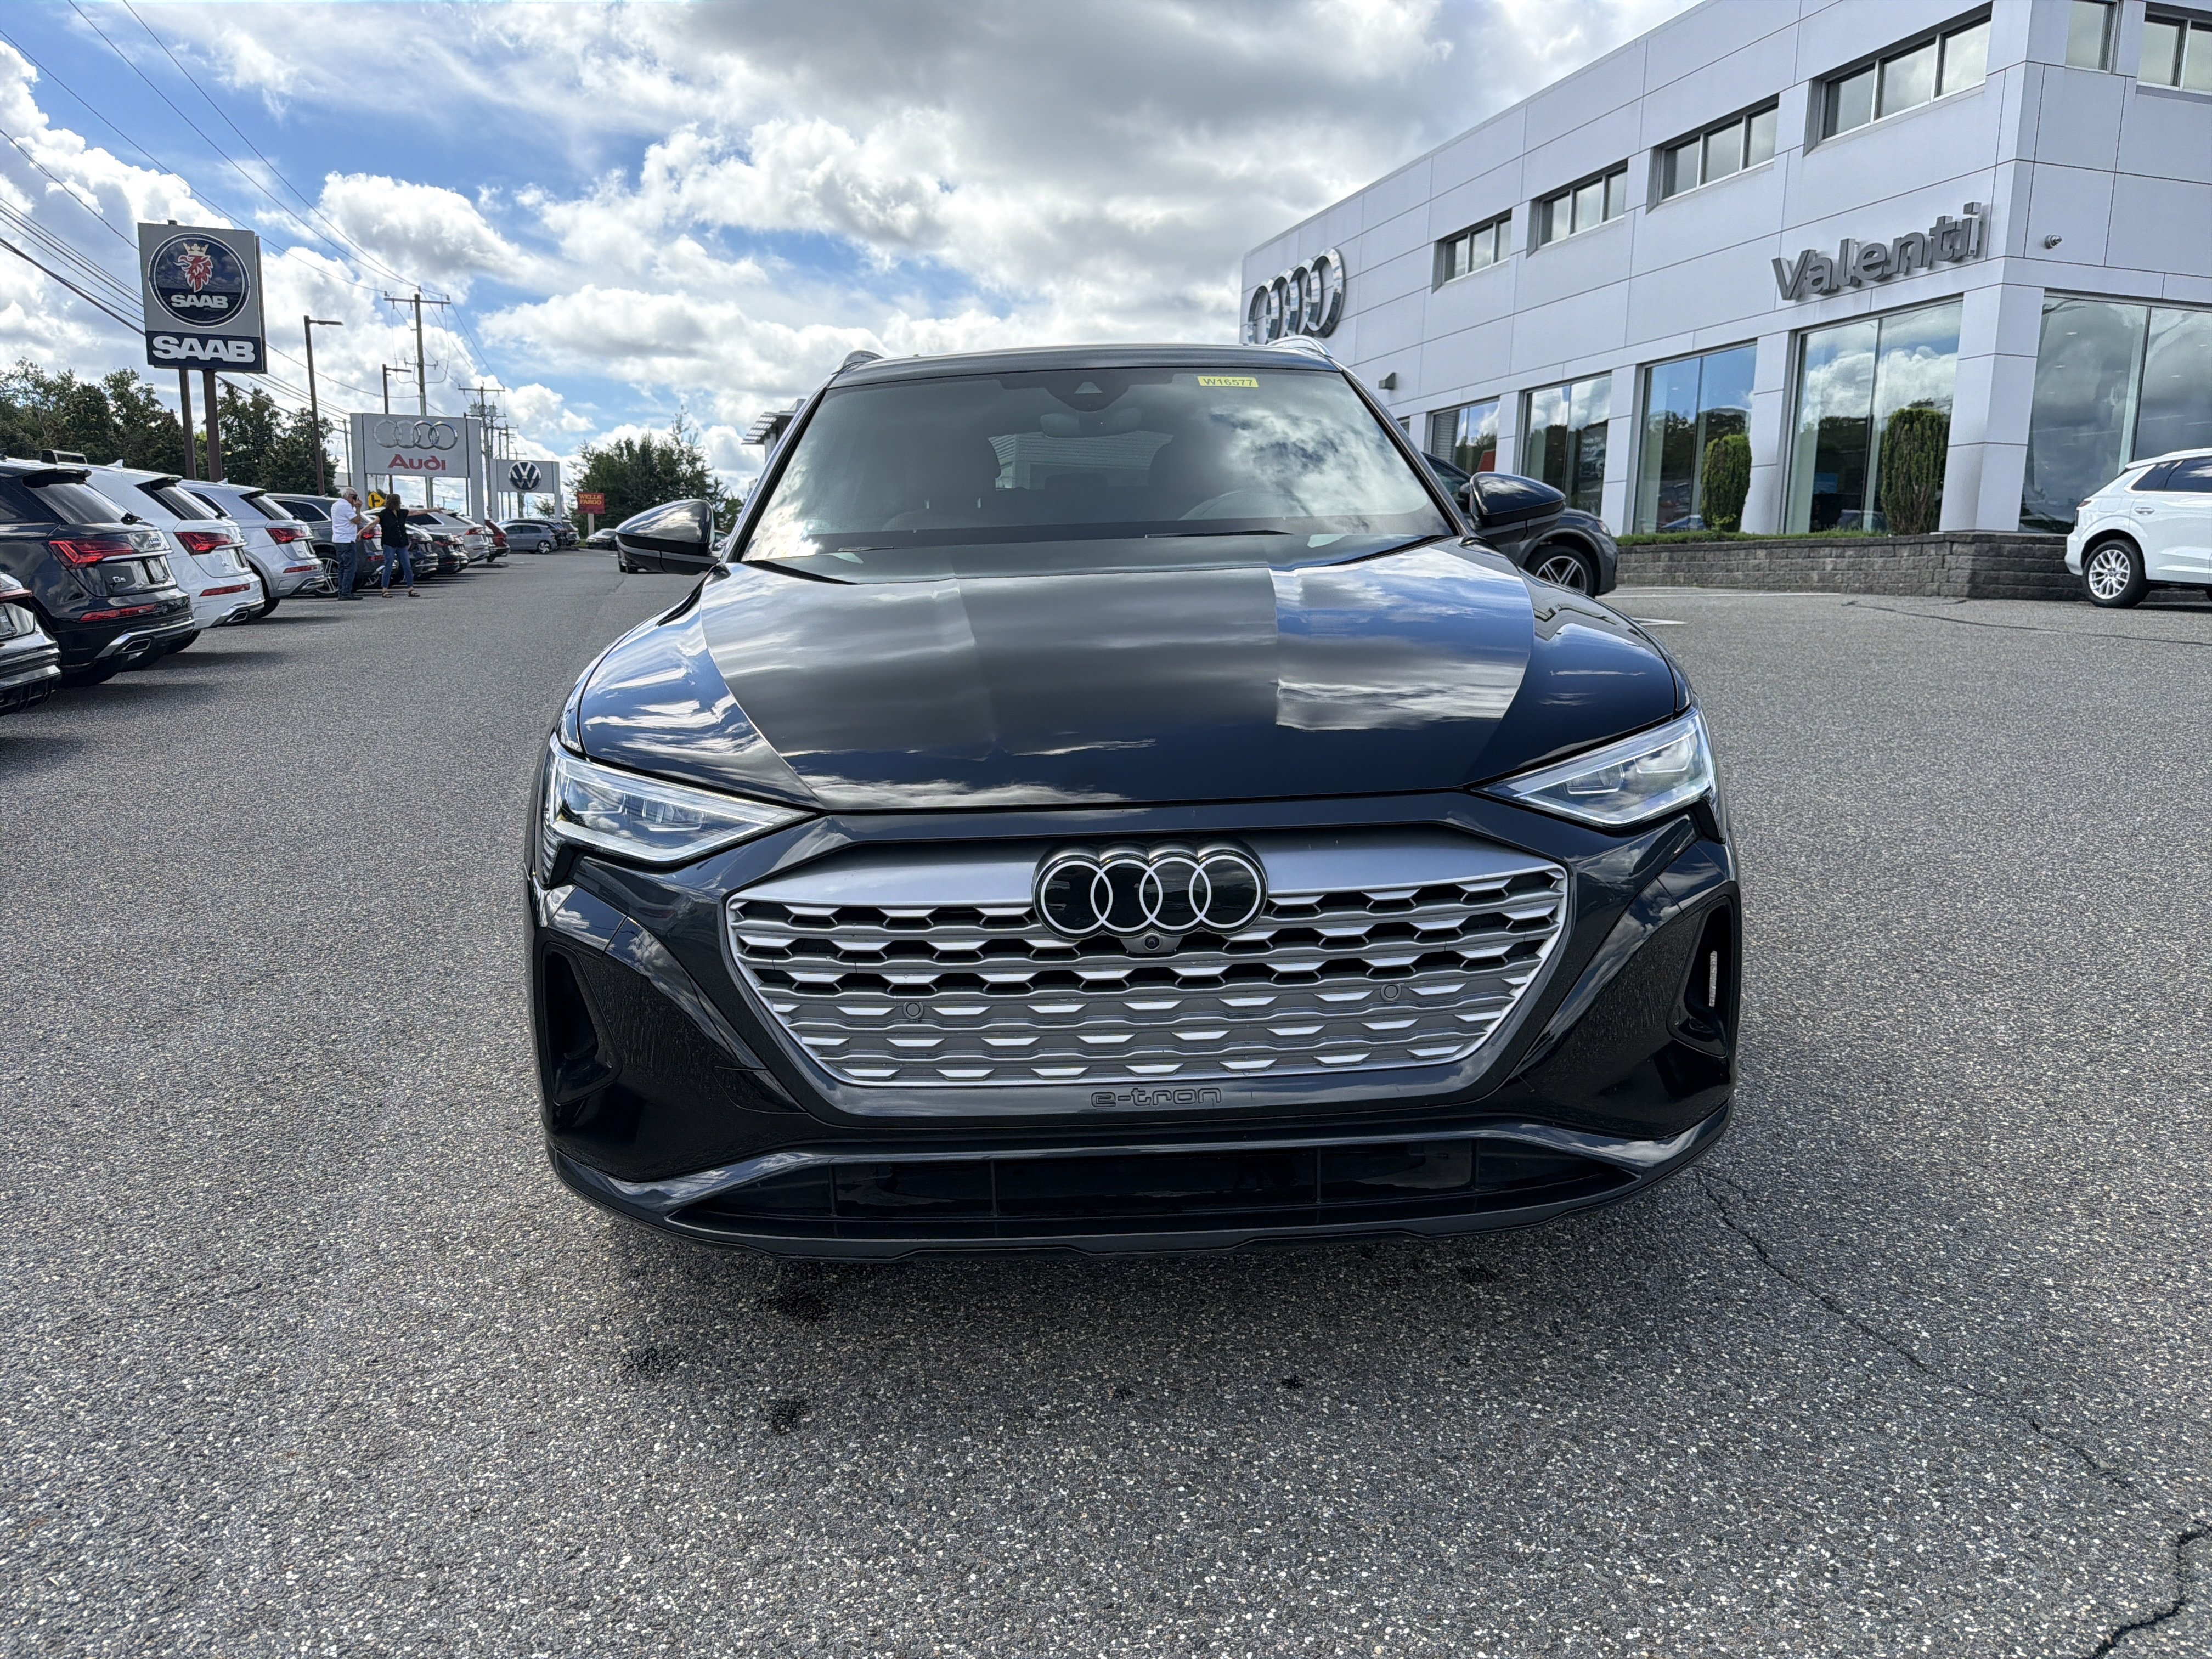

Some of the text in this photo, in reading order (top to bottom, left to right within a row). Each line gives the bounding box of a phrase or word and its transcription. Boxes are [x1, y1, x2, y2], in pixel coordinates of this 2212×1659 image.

[1771, 201, 1983, 301] Valenti
[171, 294, 229, 309] SAAB
[152, 335, 256, 363] SAAB
[1203, 378, 1253, 386] W16577
[387, 454, 447, 471] Audi
[1091, 1087, 1222, 1108] e-tron
